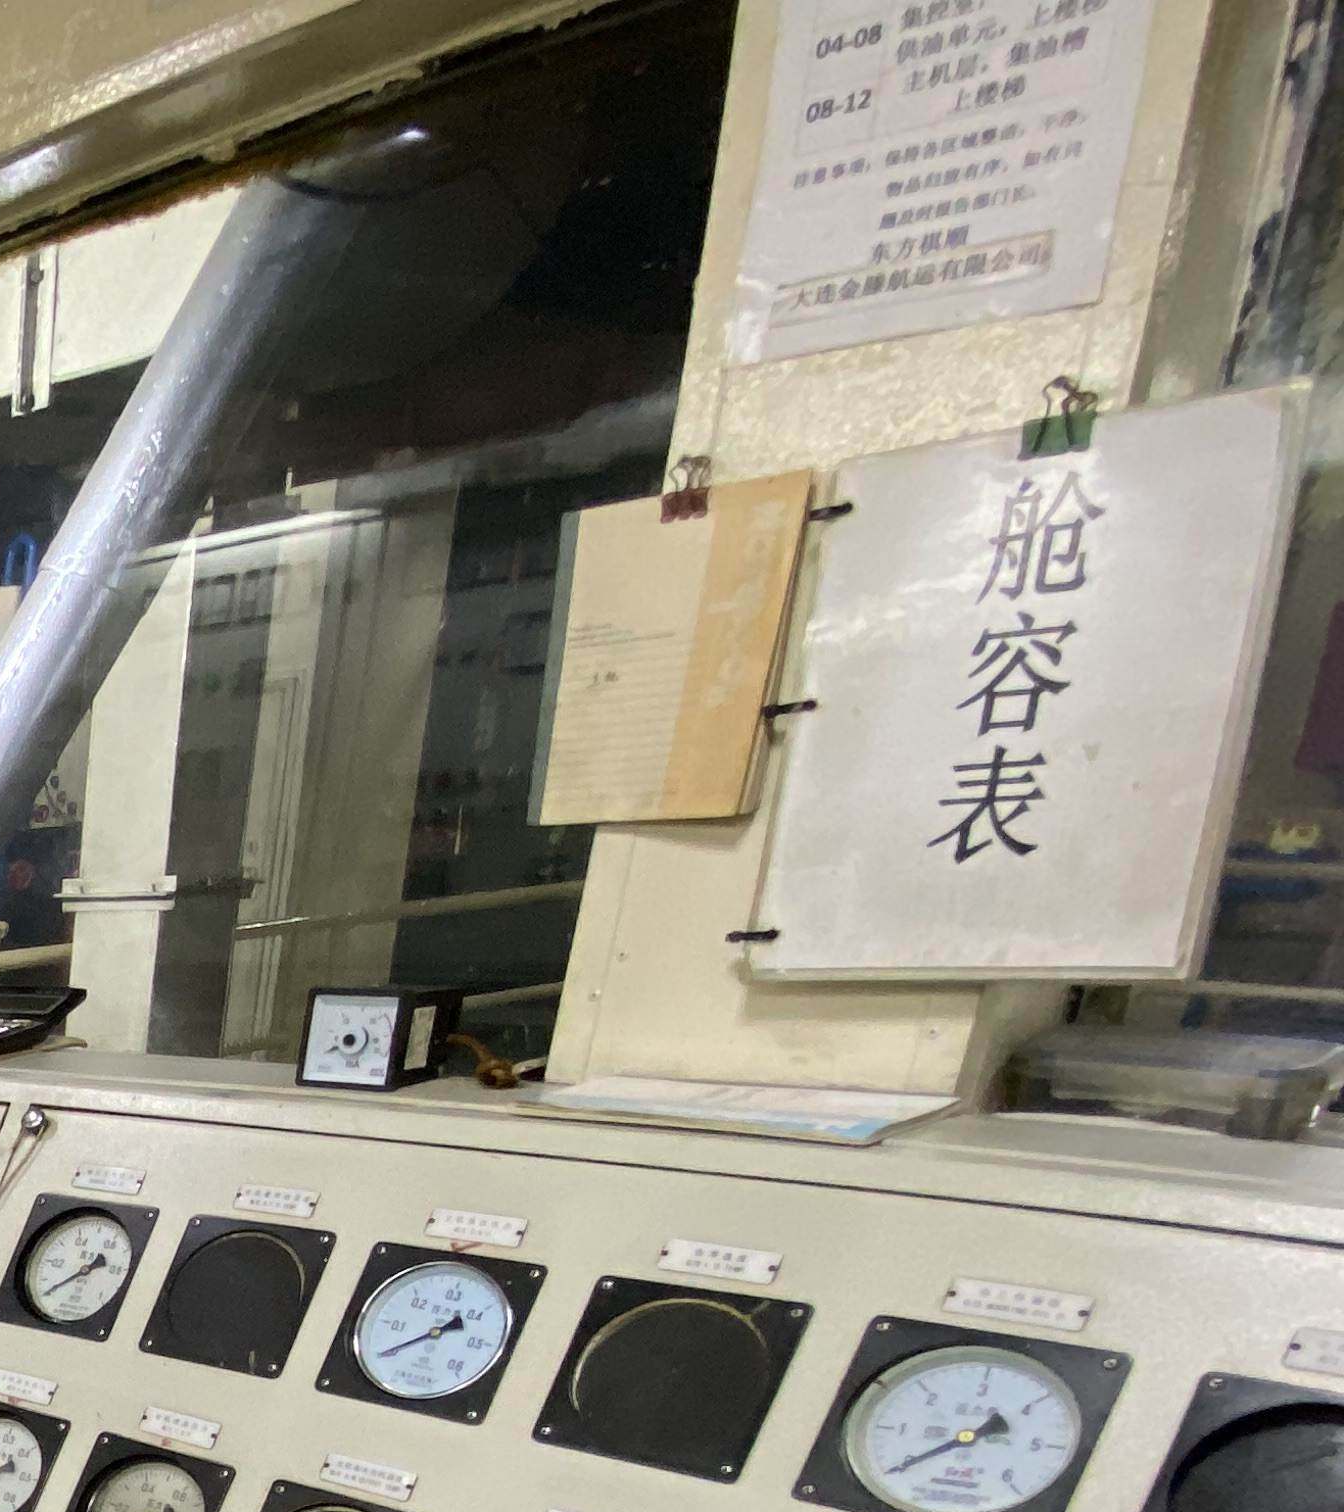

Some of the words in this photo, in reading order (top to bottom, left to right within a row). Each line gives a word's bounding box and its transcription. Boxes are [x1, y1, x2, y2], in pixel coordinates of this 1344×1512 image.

[815, 24, 882, 60] 04-08
[806, 89, 873, 123] 08-12
[927, 471, 1106, 864] 舱容表
[445, 1288, 463, 1302] 0.3
[411, 1297, 428, 1311] 0.2
[466, 1308, 483, 1322] 0.4
[391, 1318, 406, 1332] 0.1
[466, 1336, 483, 1350] 0.5
[976, 1383, 988, 1397] 3
[926, 1392, 938, 1406] 2
[1021, 1402, 1033, 1416] 4
[1030, 1437, 1043, 1452] 5
[1002, 1468, 1014, 1483] 6
